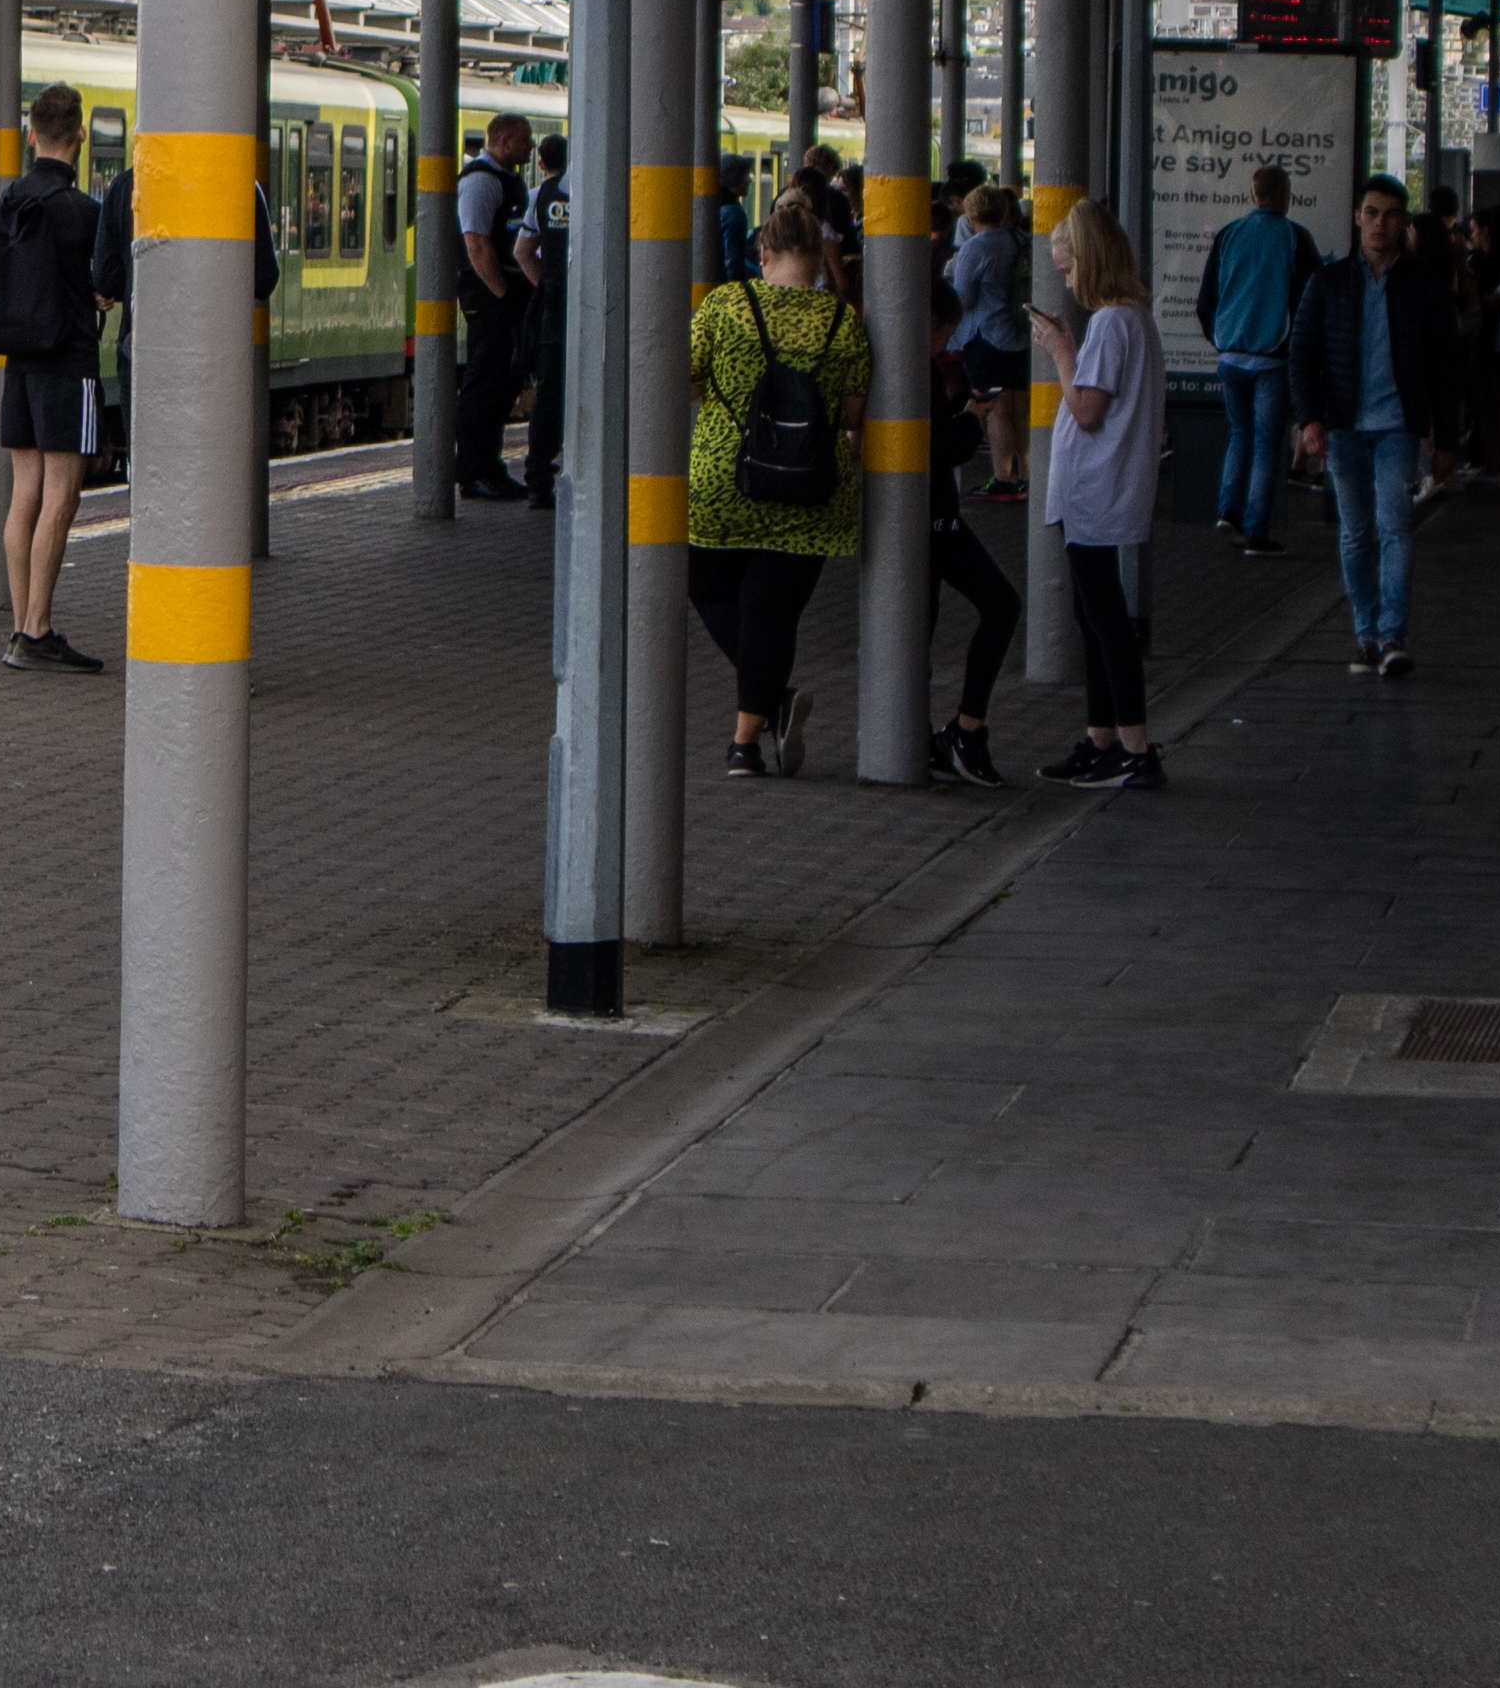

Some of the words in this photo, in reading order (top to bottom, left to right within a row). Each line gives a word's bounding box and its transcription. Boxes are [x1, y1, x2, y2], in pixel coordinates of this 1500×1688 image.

[1153, 65, 1238, 102] migo
[1153, 124, 1164, 144] t
[1172, 123, 1254, 150] Amigo
[1261, 127, 1335, 149] Loans
[1186, 154, 1233, 179] say
[1184, 189, 1208, 204] the
[1212, 191, 1251, 205] bank
